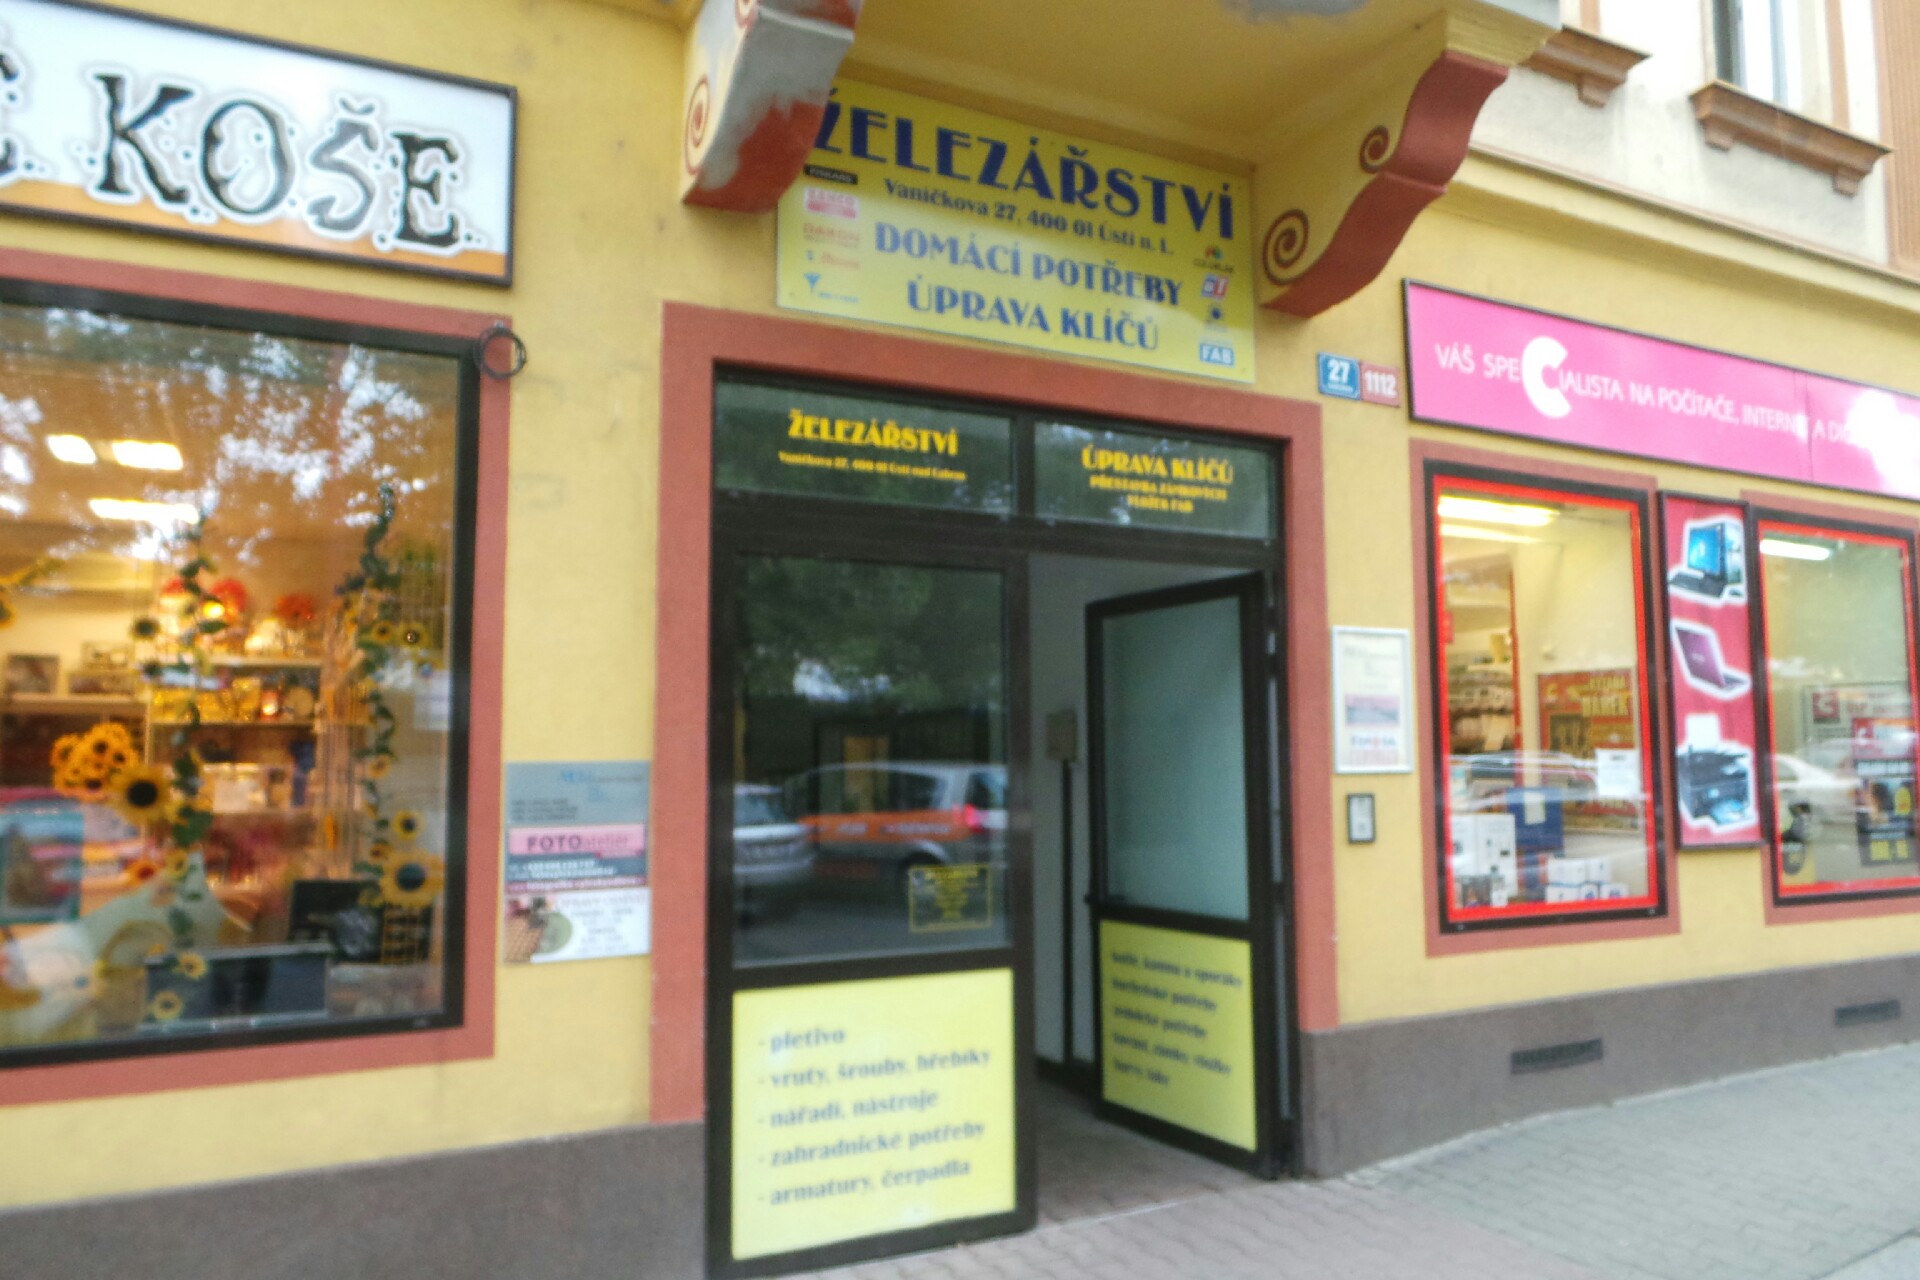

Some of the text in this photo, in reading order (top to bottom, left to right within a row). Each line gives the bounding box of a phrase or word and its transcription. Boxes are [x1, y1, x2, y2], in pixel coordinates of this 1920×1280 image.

[93, 73, 460, 248] KOŠE
[874, 220, 1182, 306] DOMÁCÍ POTŘEBY
[906, 274, 1159, 350] ÚPRAVA KLÍČŮ
[1328, 358, 1350, 384] 27
[1364, 370, 1398, 398] 1112
[1435, 341, 1475, 374] VÁŠ
[1629, 381, 1652, 410] NA
[787, 408, 958, 456] ŽELEZÁŘSTVÍ
[1082, 443, 1168, 477] ÚPRAVA
[770, 1028, 845, 1054] pletivo
[908, 1120, 985, 1149] potřeby
